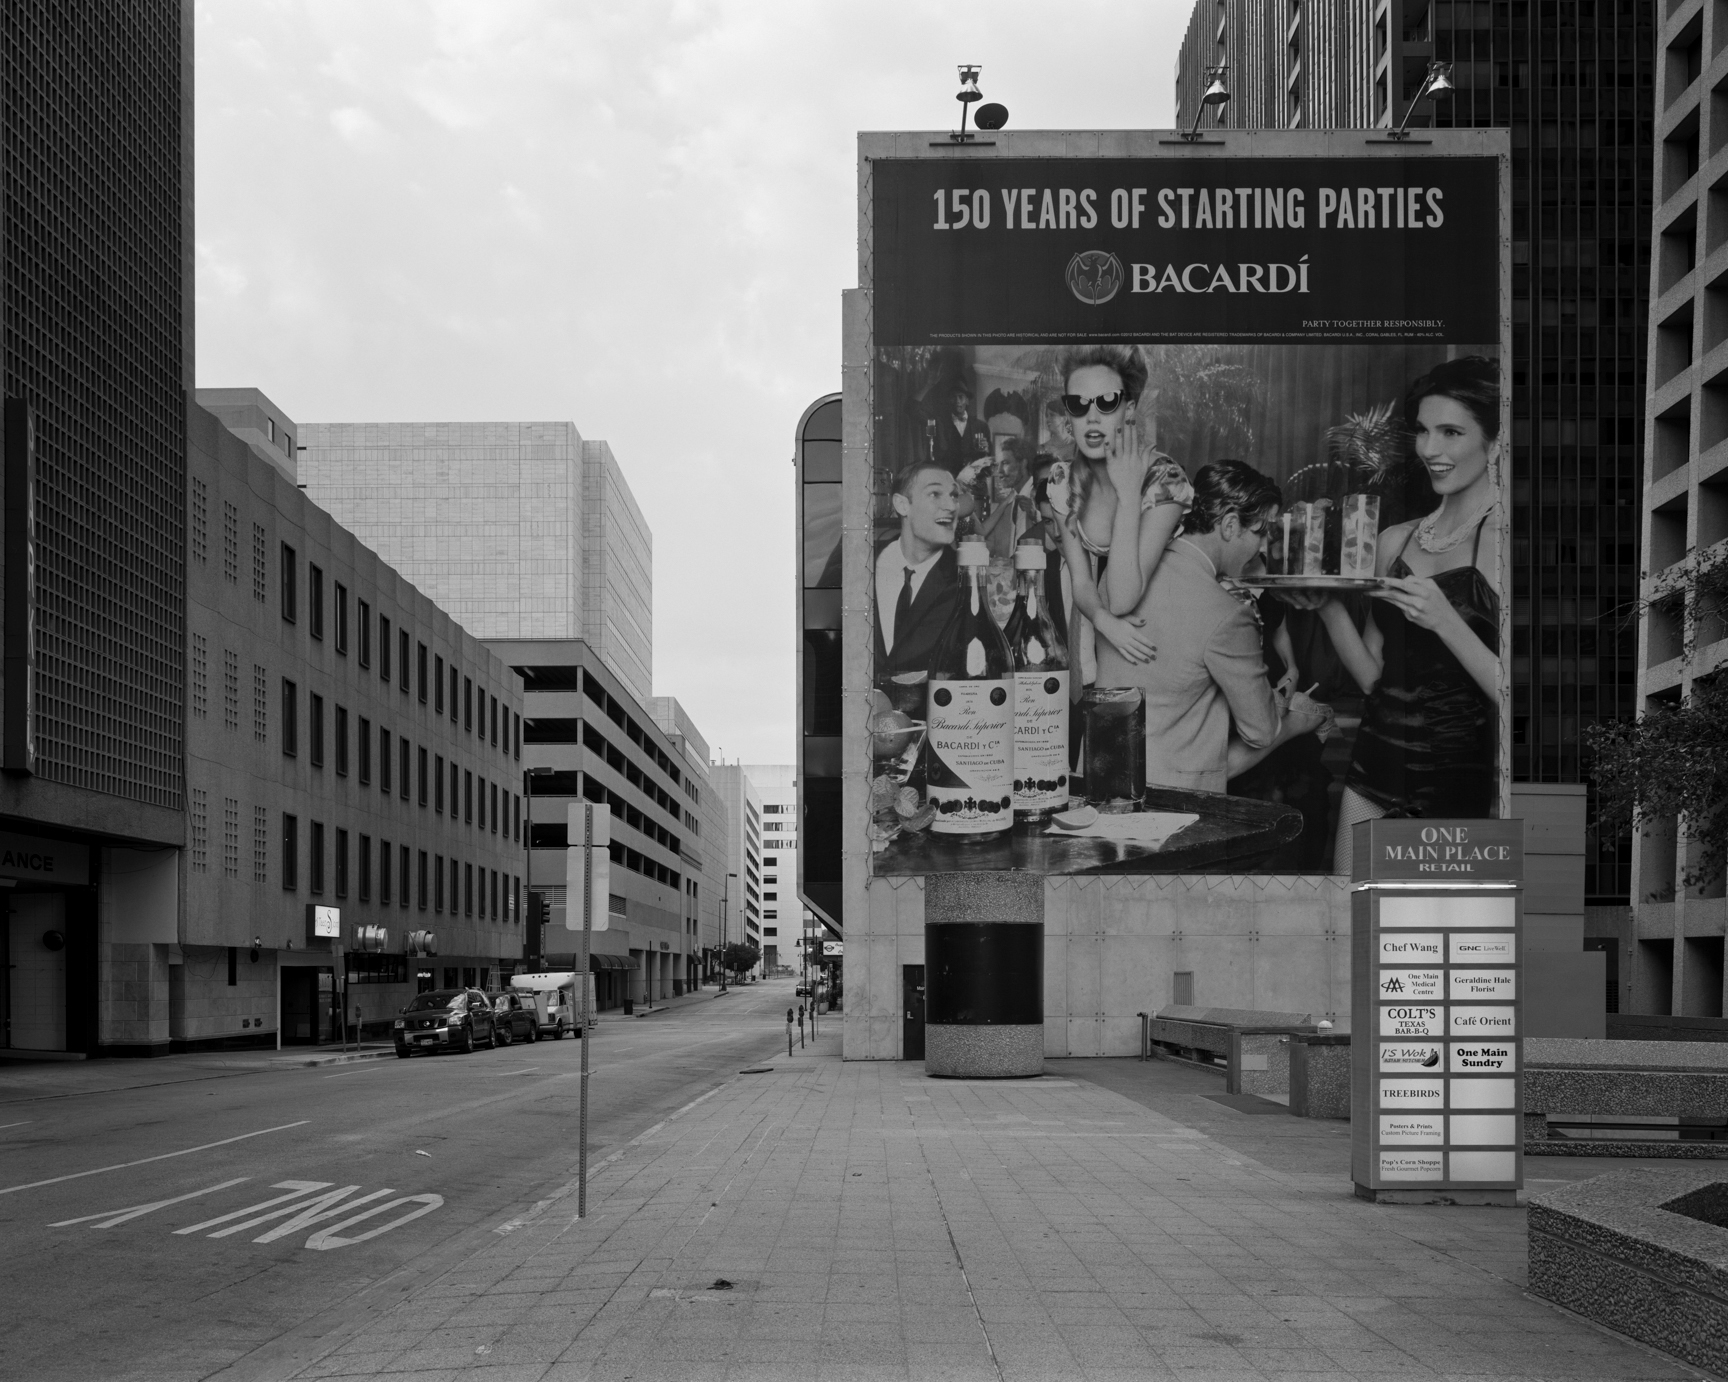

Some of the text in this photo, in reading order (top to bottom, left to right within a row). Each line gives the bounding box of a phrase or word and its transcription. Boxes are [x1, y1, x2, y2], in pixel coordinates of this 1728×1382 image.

[933, 187, 1445, 230] 150 YEARS OF STARTING PARTIES
[1130, 254, 1311, 293] BACARDÍ
[1302, 320, 1446, 328] PARTY TOGETHER RESPONSIBLY.
[936, 741, 980, 750] BACARDI
[1421, 827, 1469, 844] ONE
[1385, 845, 1510, 861] MAIN PLACE
[1419, 863, 1475, 872] RETAIL
[1383, 942, 1439, 954] Chef Wang
[1454, 976, 1512, 984] Geraldine Hale
[1471, 985, 1495, 993] Florist
[1387, 1008, 1436, 1019] COLT'S
[1398, 1020, 1426, 1028] TEXAS
[1454, 1016, 1511, 1026] Café Orient
[1395, 1028, 1429, 1036] BAR-B-Q
[1401, 1048, 1426, 1058] Wok
[1457, 1048, 1508, 1057] One Main
[1461, 1058, 1503, 1069] Sundry
[1382, 1089, 1440, 1098] TREEBIRDS
[47, 1177, 444, 1251] ONLY
